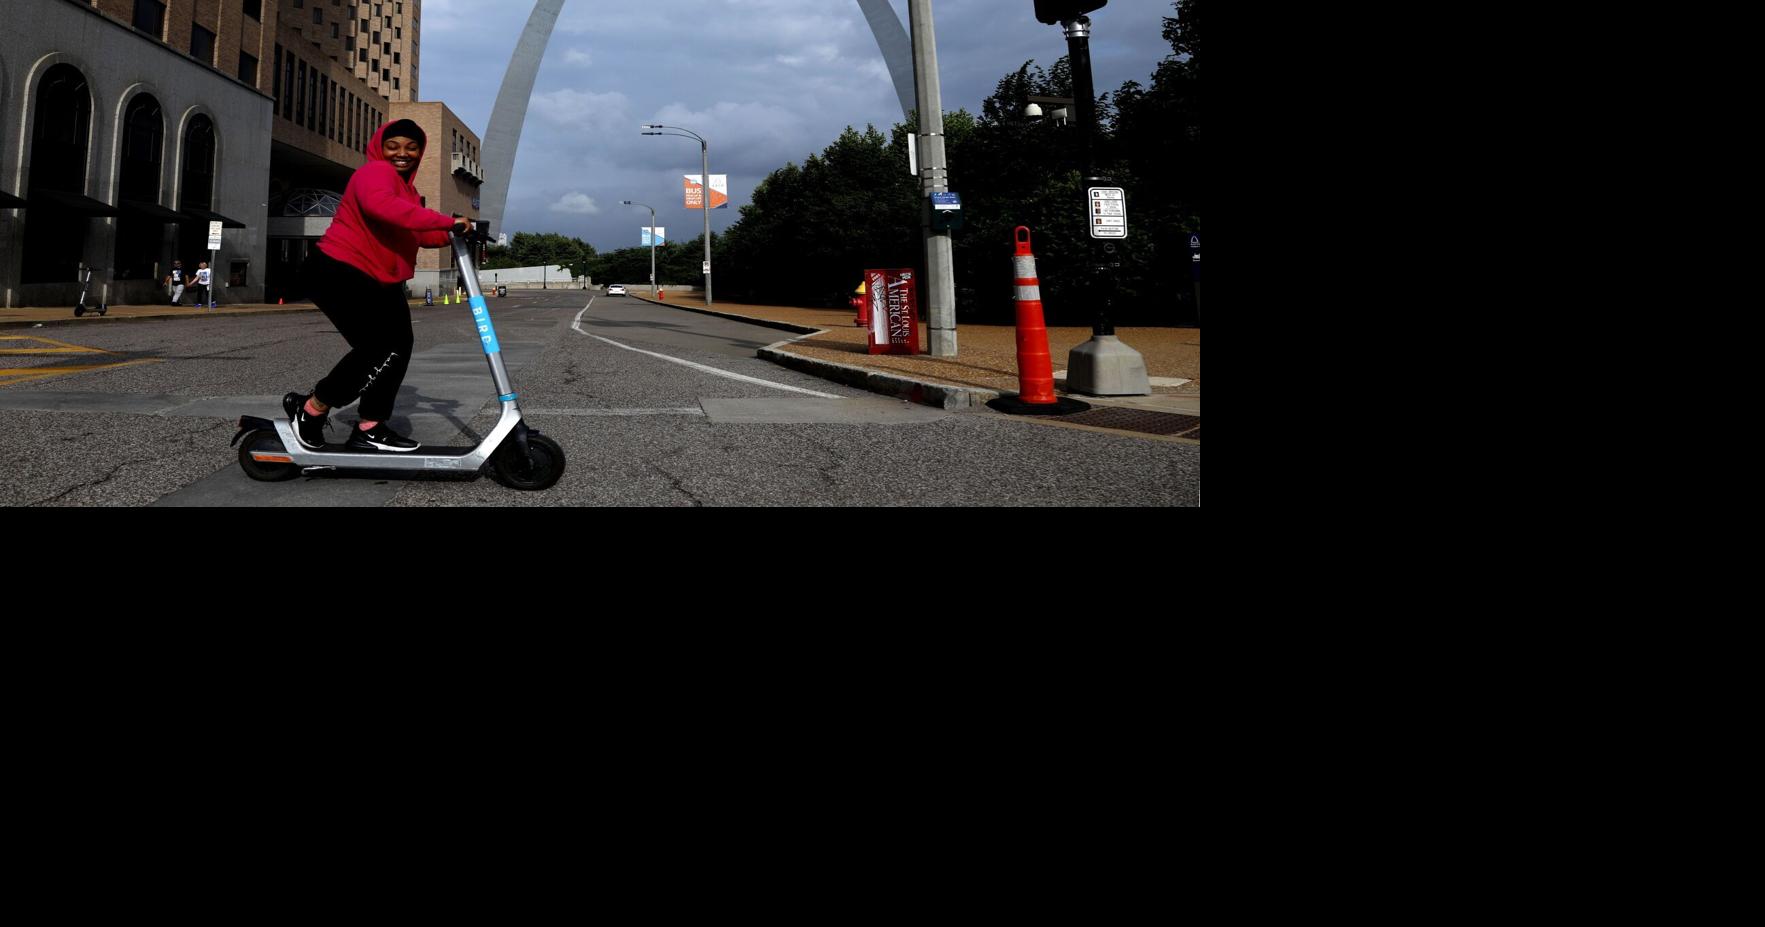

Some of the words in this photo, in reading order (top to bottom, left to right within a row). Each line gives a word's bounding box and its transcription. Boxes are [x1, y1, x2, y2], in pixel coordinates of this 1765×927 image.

[887, 276, 908, 337] AMERICAN
[900, 288, 909, 303] THE
[472, 306, 492, 345] BIRD
[901, 316, 910, 337] LOUIS
